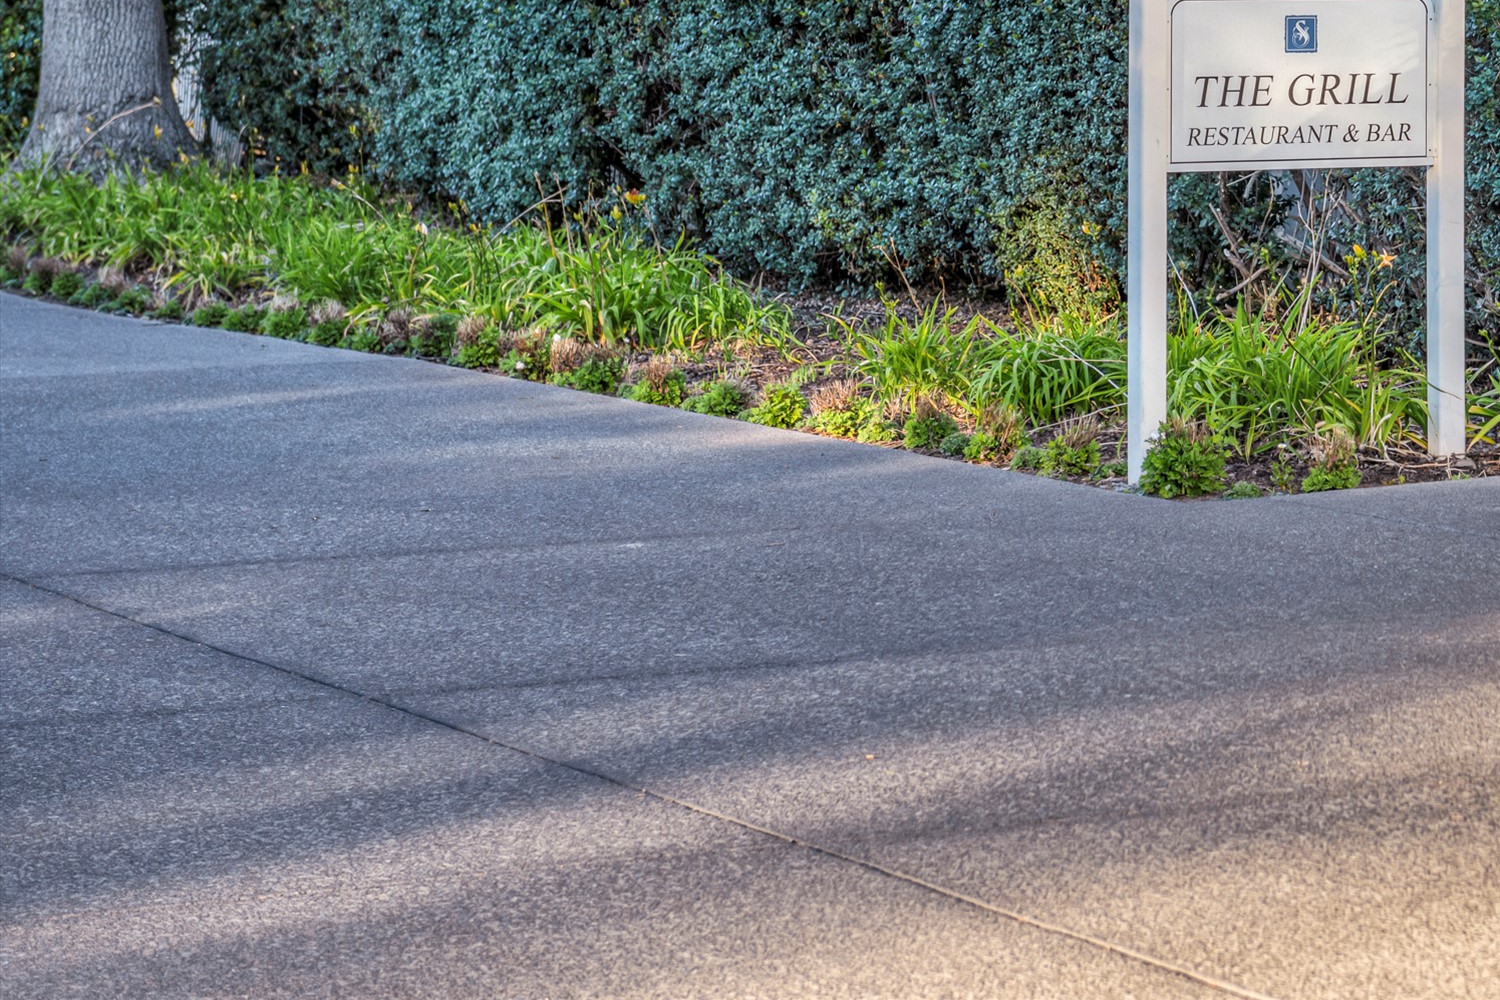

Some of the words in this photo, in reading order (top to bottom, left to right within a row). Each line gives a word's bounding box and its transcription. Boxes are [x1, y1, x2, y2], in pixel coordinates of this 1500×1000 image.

[1194, 75, 1274, 108] THE
[1288, 72, 1410, 106] GRILL
[1186, 124, 1338, 147] RESTAURANT
[1342, 123, 1359, 143] &
[1365, 122, 1412, 143] BAR
